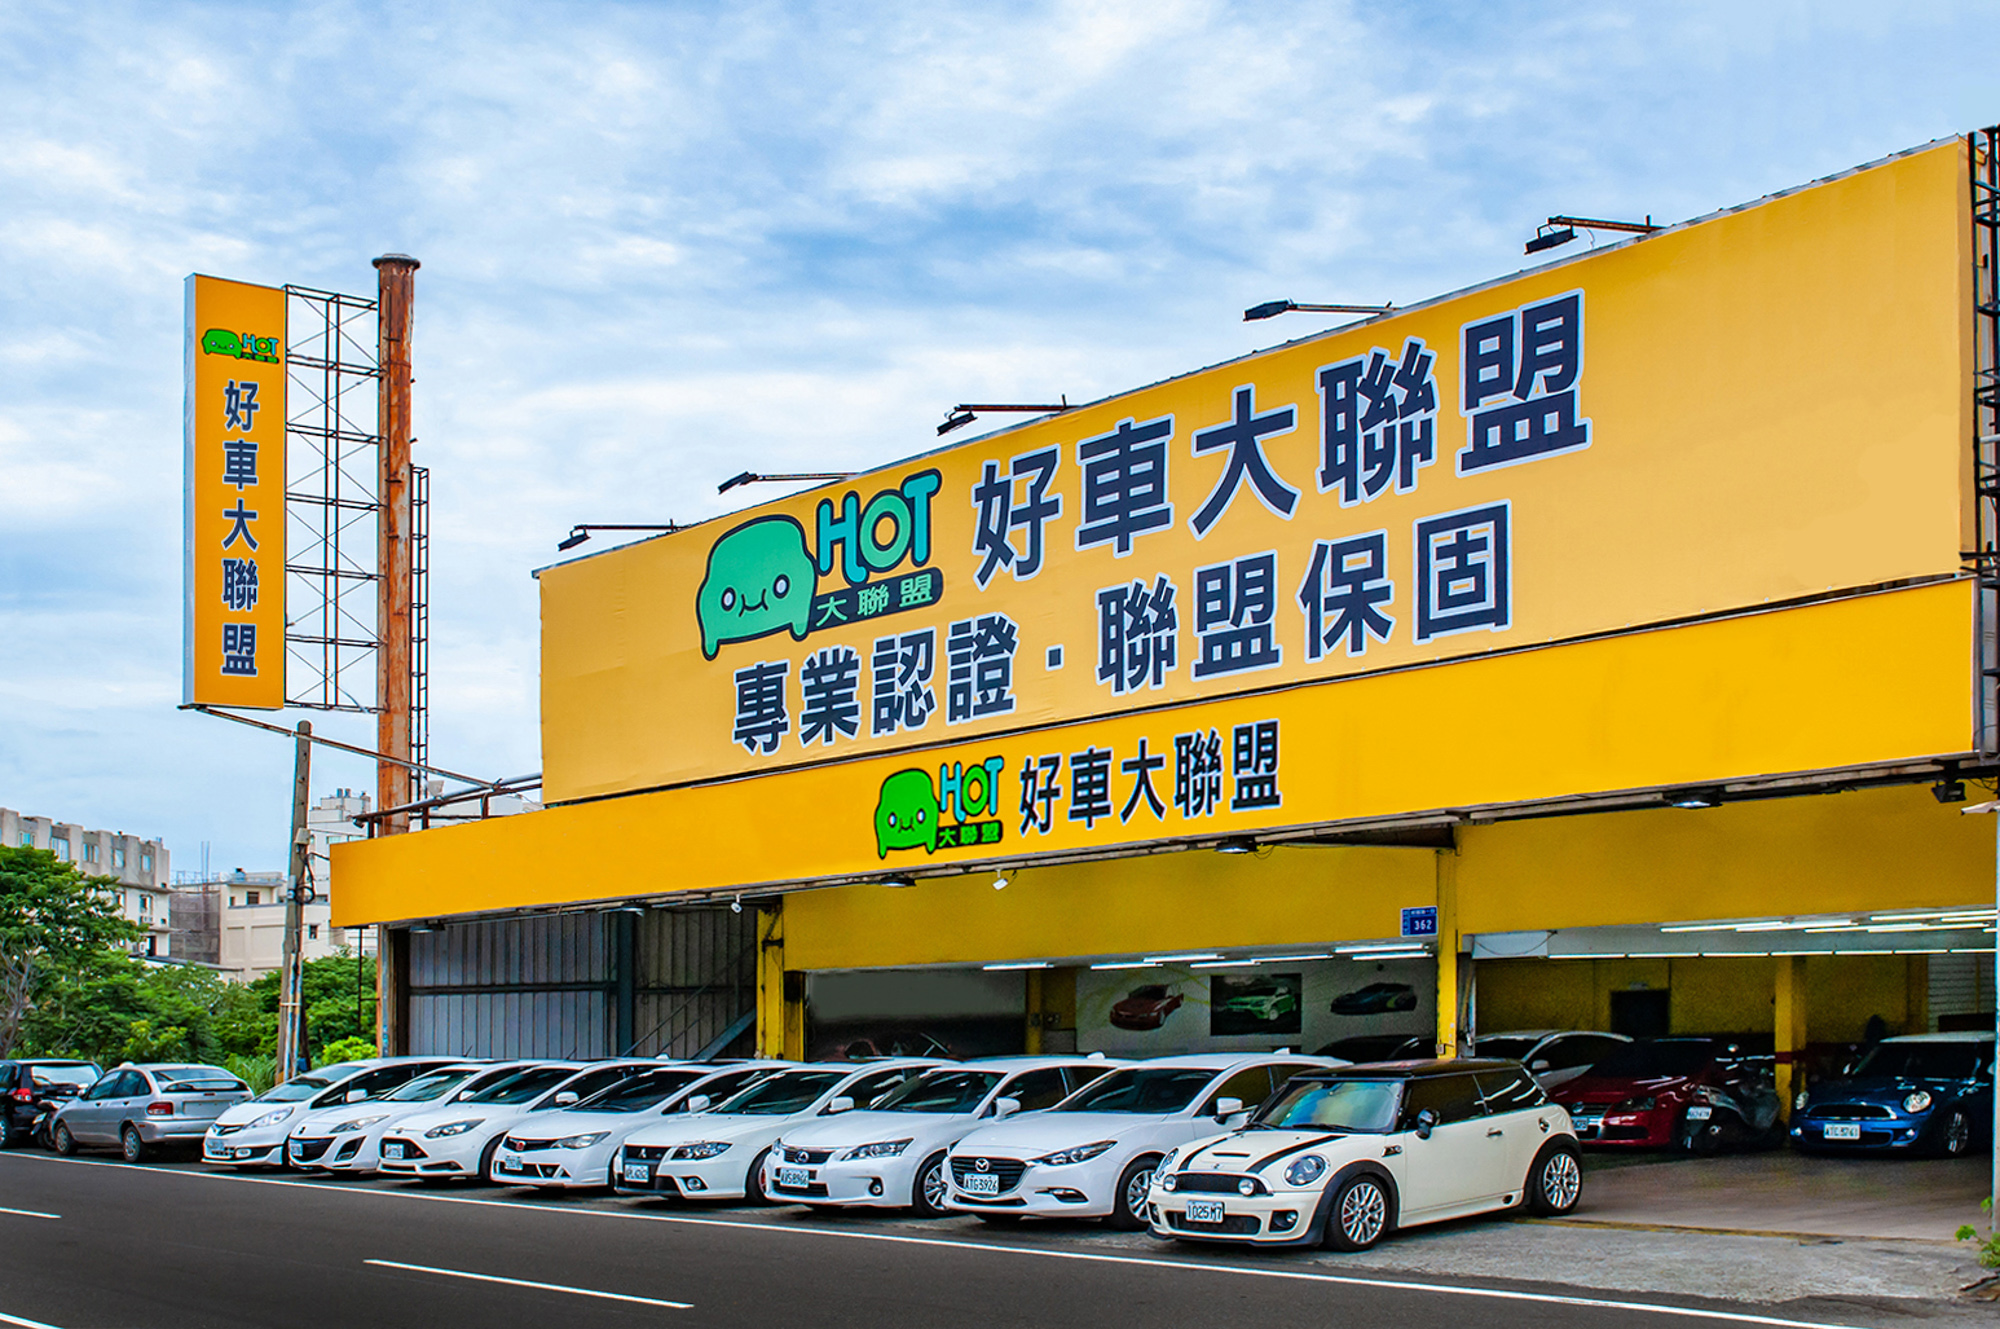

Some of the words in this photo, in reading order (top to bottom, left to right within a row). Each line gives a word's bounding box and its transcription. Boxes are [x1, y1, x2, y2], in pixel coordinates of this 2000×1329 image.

[242, 333, 279, 356] HOT
[973, 288, 1592, 588] 好車大聯盟
[222, 379, 259, 677] 好車大聯盟
[816, 469, 941, 583] HOT
[815, 572, 933, 626] 大聯盟
[938, 756, 1005, 823] HOT
[1019, 719, 1281, 838] 好車大聯盟
[938, 824, 1000, 848] 大聯盟
[1414, 919, 1433, 931] 362
